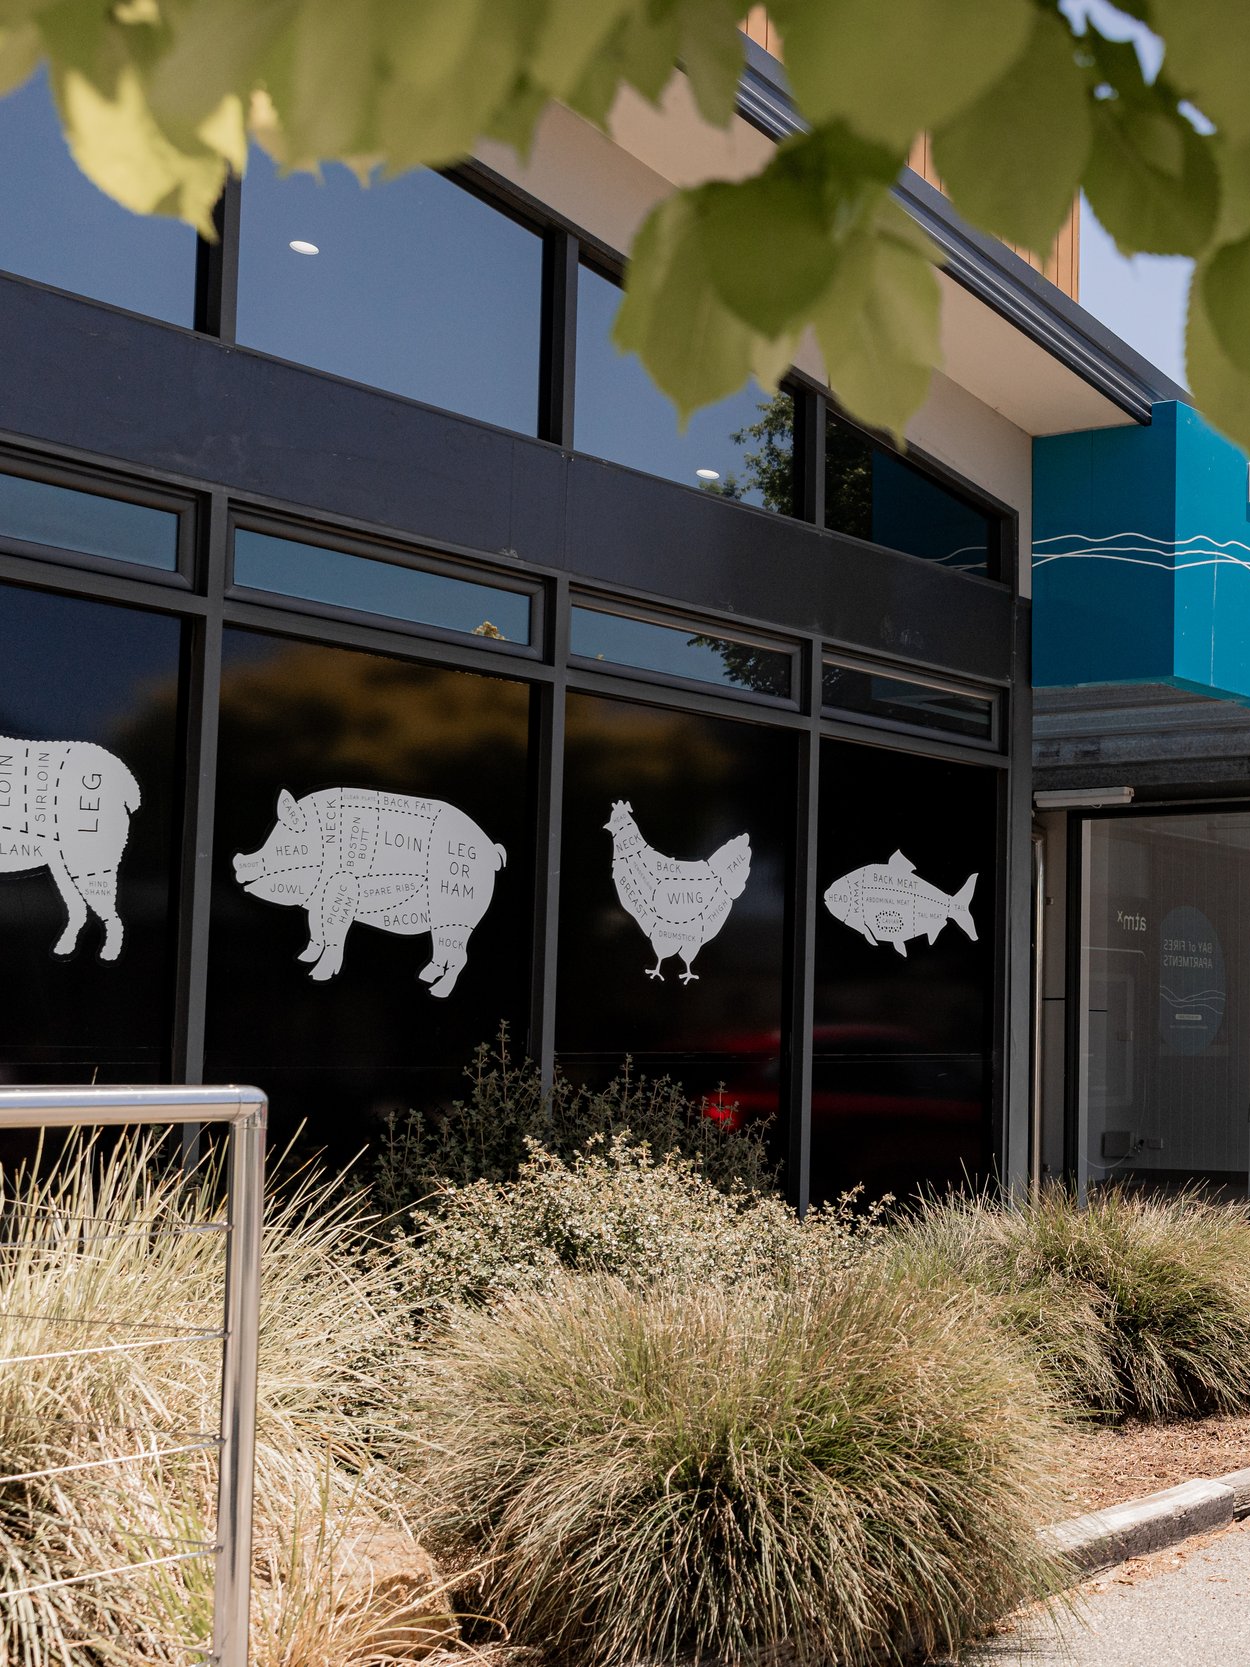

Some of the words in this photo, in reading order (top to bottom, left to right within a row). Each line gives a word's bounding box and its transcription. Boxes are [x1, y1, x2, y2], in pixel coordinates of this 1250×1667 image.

[35, 752, 50, 822] SIRLOIN
[78, 773, 102, 832] LEG
[282, 797, 299, 825] EARS
[383, 796, 410, 808] BACK
[415, 802, 432, 812] FAT
[325, 799, 336, 844] NECK
[0, 843, 43, 857] LANK
[275, 844, 309, 856] HEAD
[347, 816, 361, 867] BOSTON
[358, 828, 370, 859] BUTT
[384, 831, 422, 852] LOIN
[448, 840, 477, 860] LEG
[616, 833, 641, 853] NECK
[449, 861, 470, 878] OR
[656, 861, 681, 873] BACK
[727, 854, 746, 874] TAIL
[270, 884, 304, 895] JOWL
[363, 886, 392, 897] SPARE
[396, 883, 416, 892] RIBS
[440, 879, 474, 900] HAM
[873, 873, 894, 885] BACK
[897, 877, 919, 890] MEAT
[327, 884, 347, 925] PICNIC
[619, 876, 648, 920] BREAST
[667, 891, 703, 905] WING
[828, 894, 848, 904] HEAD
[865, 896, 895, 905] ABDOMINAL
[339, 897, 354, 923] HAM
[707, 900, 728, 923] THIGH
[954, 904, 967, 912] TAIL
[383, 912, 428, 927] BACON
[438, 937, 464, 949] HOCK
[658, 930, 696, 942] DRUMSTICK
